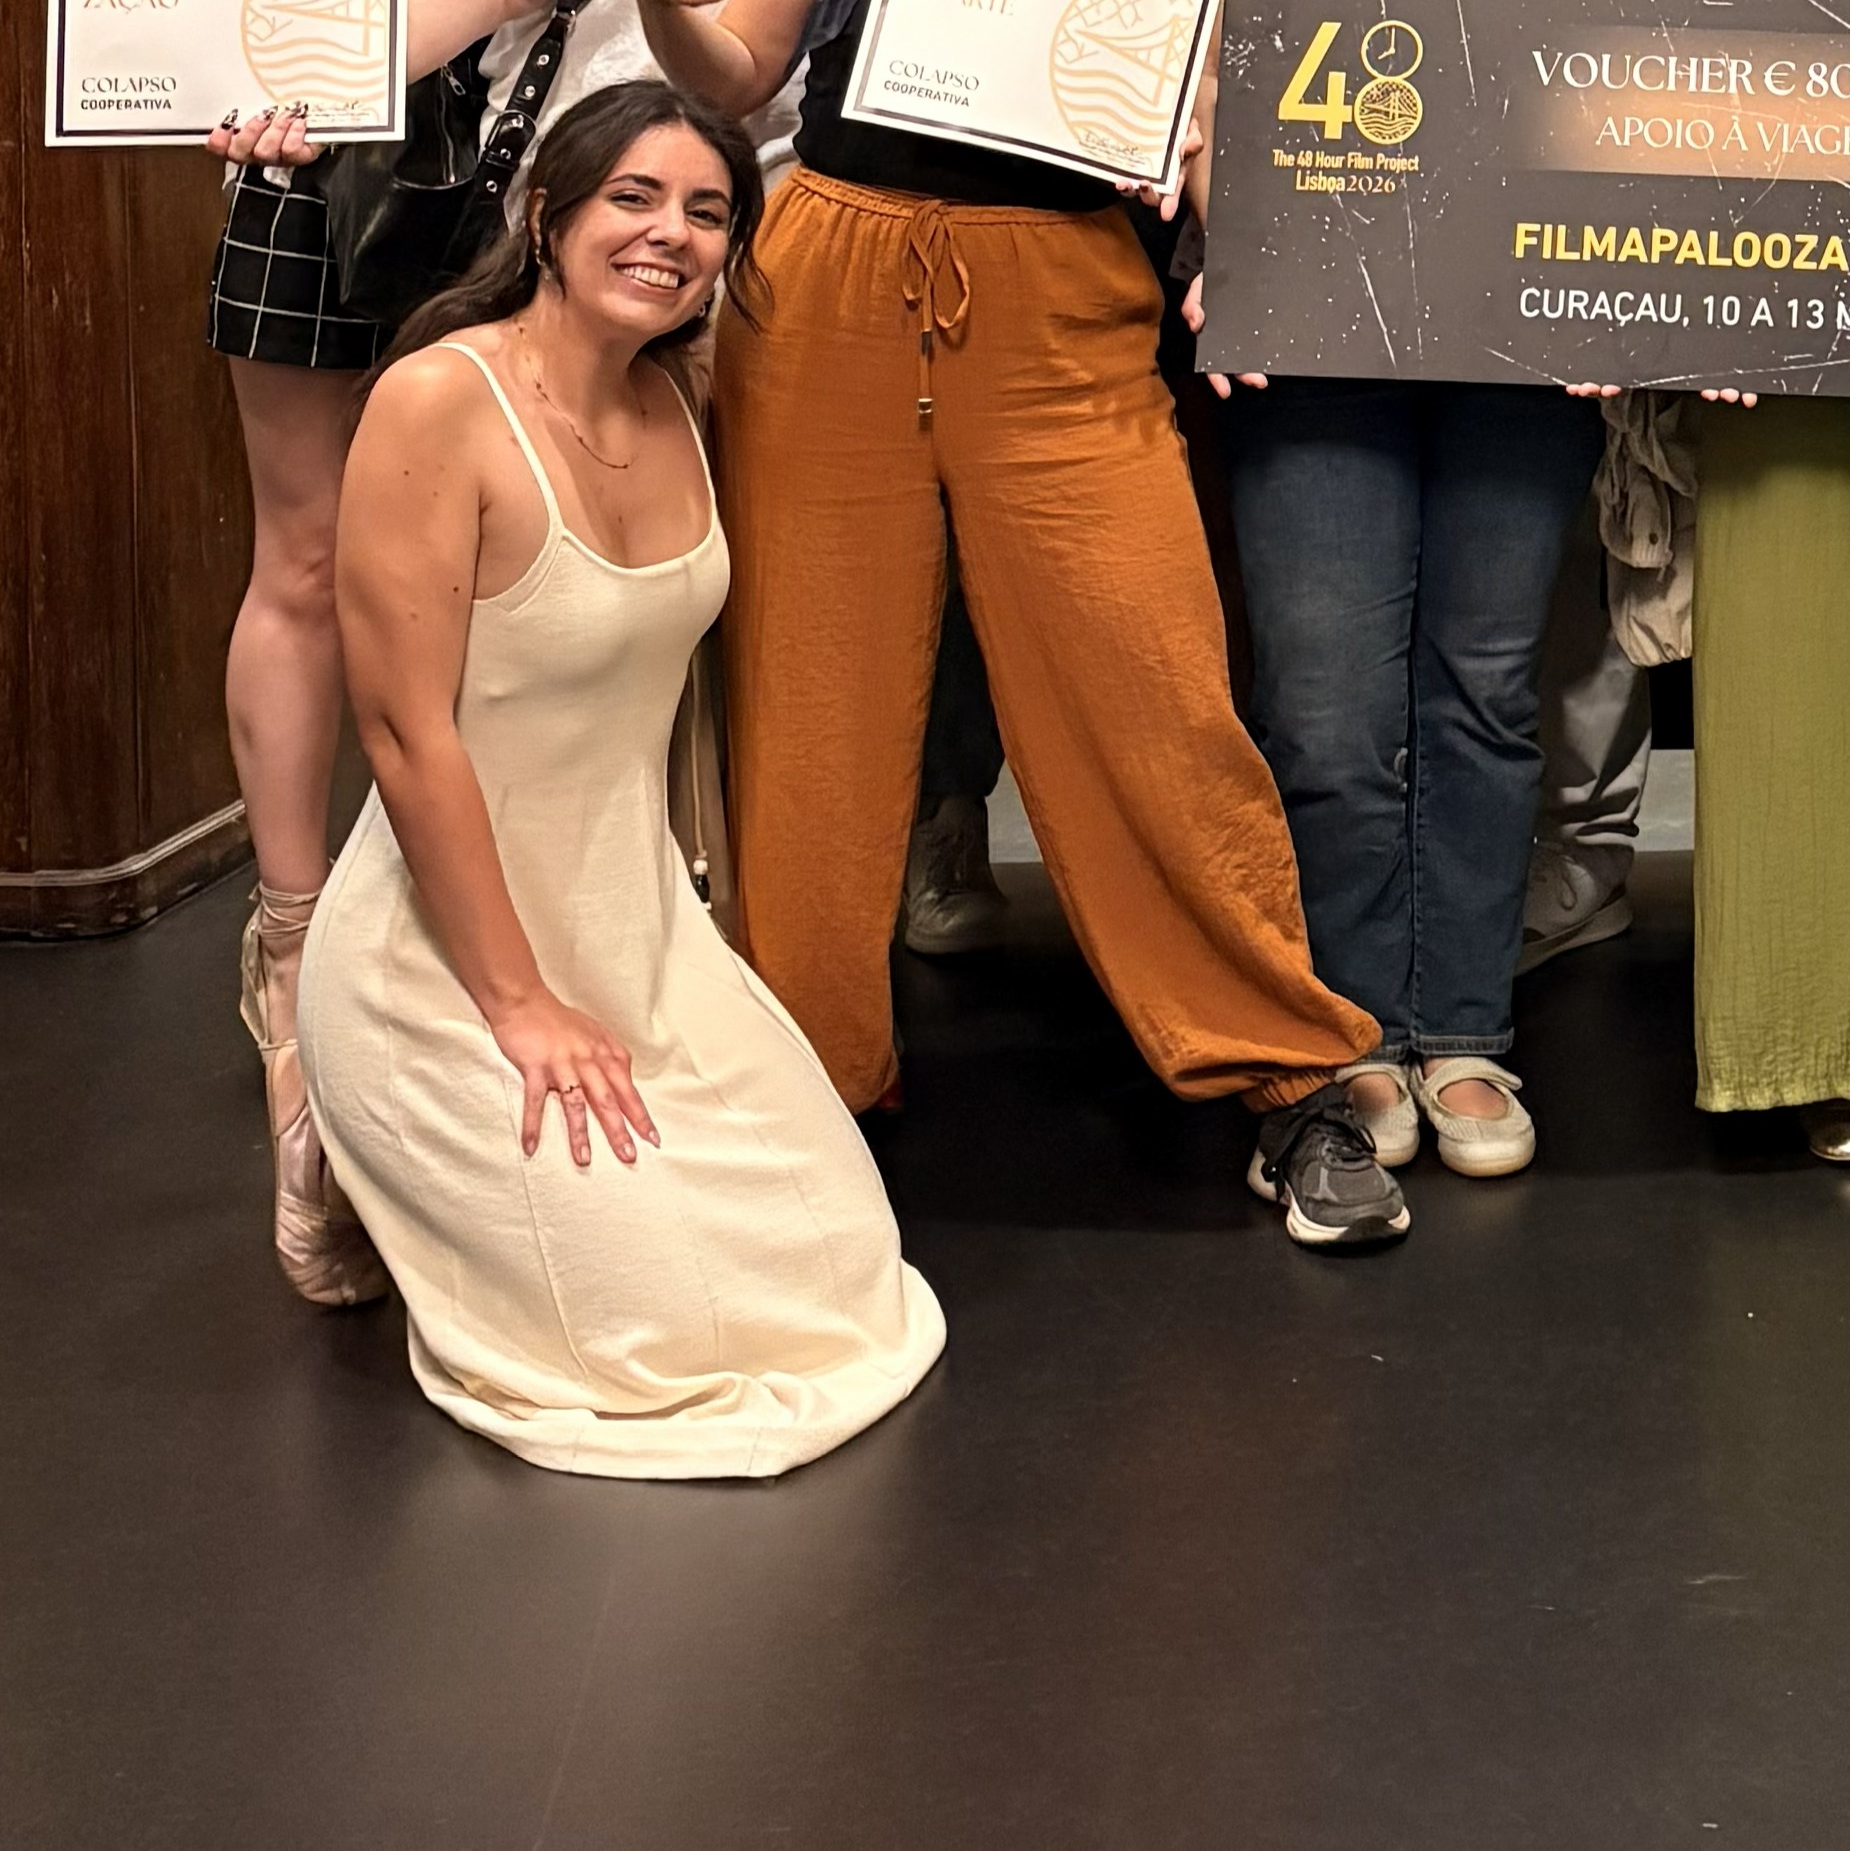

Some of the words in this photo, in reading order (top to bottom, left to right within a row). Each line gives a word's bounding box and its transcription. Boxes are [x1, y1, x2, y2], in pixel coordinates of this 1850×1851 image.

[81, 76, 177, 94] COLAPSO
[889, 60, 979, 91] COLAPSO
[1532, 50, 1756, 95] VOUCHER
[1764, 60, 1797, 96] €
[81, 98, 172, 111] COOPERATIVA
[884, 80, 969, 107] COOPERATIVA
[1596, 116, 1714, 151] APOIO
[1722, 115, 1748, 152] À
[1273, 149, 1295, 166] The
[1297, 150, 1313, 167] 48
[1315, 151, 1346, 168] Hour
[1347, 152, 1374, 170] Film
[1376, 153, 1419, 173] Project
[1296, 170, 1346, 191] Lisboa
[1346, 175, 1396, 193] 2026
[1514, 222, 1849, 272] FILMAPALOOZA
[1519, 287, 1690, 327] CURAÇAU,
[1703, 295, 1741, 326] 10
[1751, 297, 1775, 328] A
[1787, 298, 1825, 330] 13
